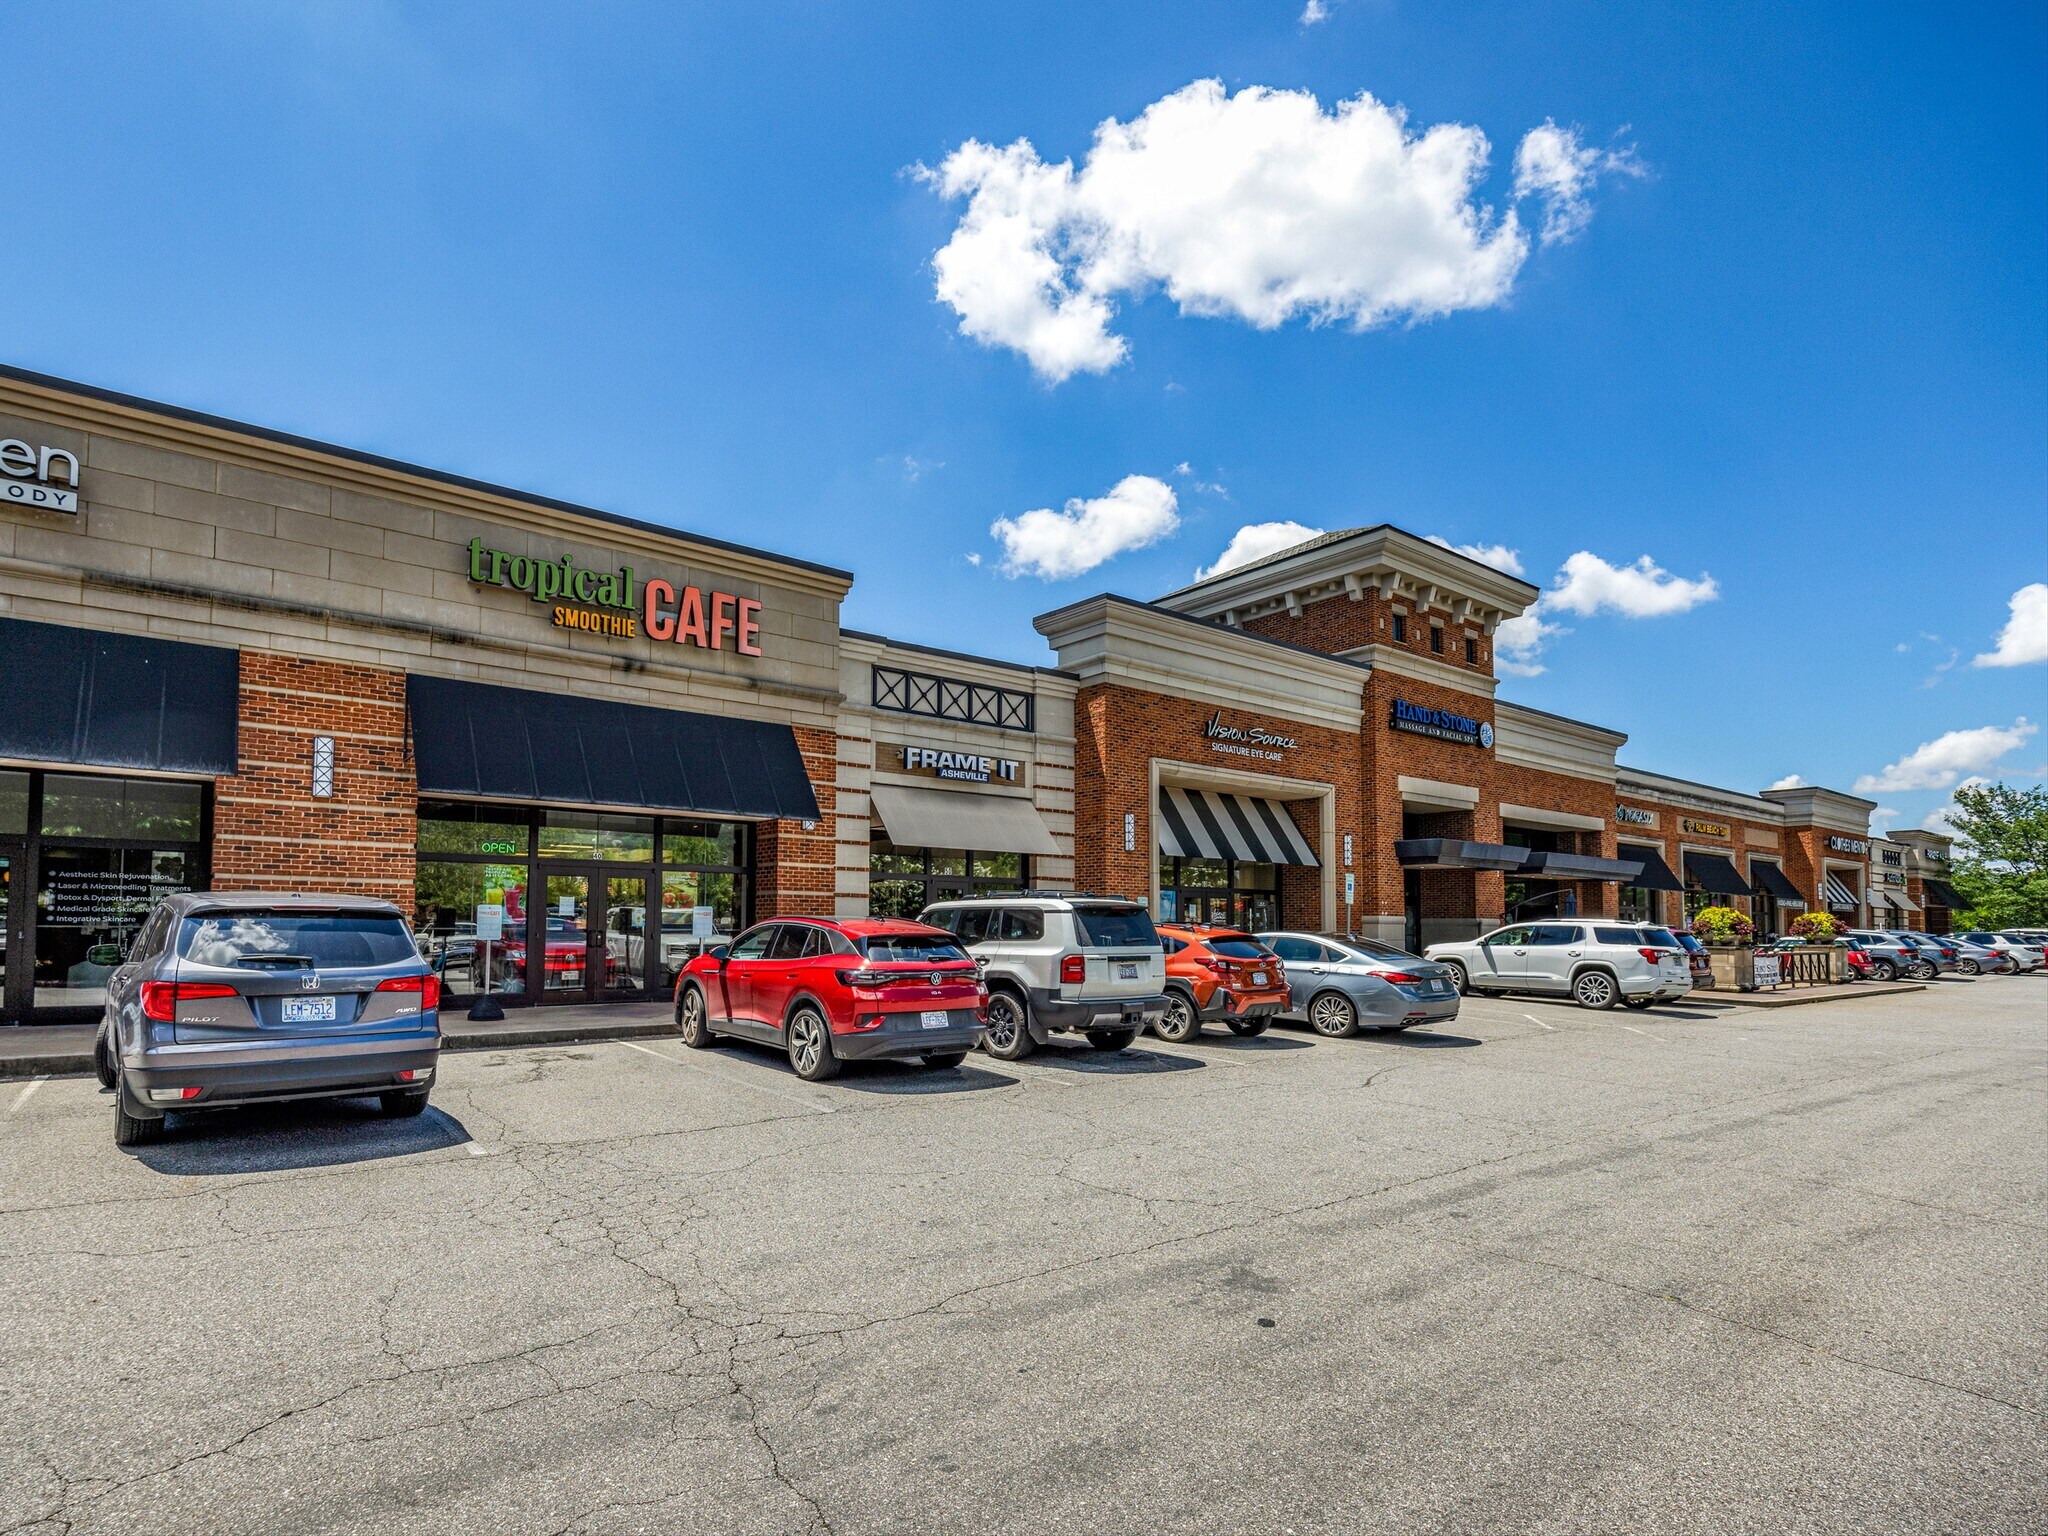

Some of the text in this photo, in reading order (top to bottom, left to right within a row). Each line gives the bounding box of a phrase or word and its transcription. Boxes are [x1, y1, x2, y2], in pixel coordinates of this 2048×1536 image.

[467, 537, 635, 610] tropical
[553, 606, 636, 639] SMOOTHIE
[644, 578, 763, 657] CAFE
[1432, 711, 1440, 725] &
[1399, 721, 1426, 733] MASSAGE
[1442, 731, 1462, 740] FACIAL
[1464, 735, 1474, 743] SPA
[1211, 742, 1249, 756] SIGNATURE
[1251, 749, 1264, 758] EYE
[904, 746, 1019, 781] FRAME IT
[940, 768, 988, 782] ASHEVILLE
[1707, 824, 1719, 834] BEACH
[481, 842, 515, 854] OPEN
[58, 871, 99, 879] Aesthetic
[90, 883, 147, 892] Microneedling
[148, 884, 191, 892] Treatments
[56, 915, 100, 924] Integrative
[284, 1003, 333, 1016] LEM-7512
